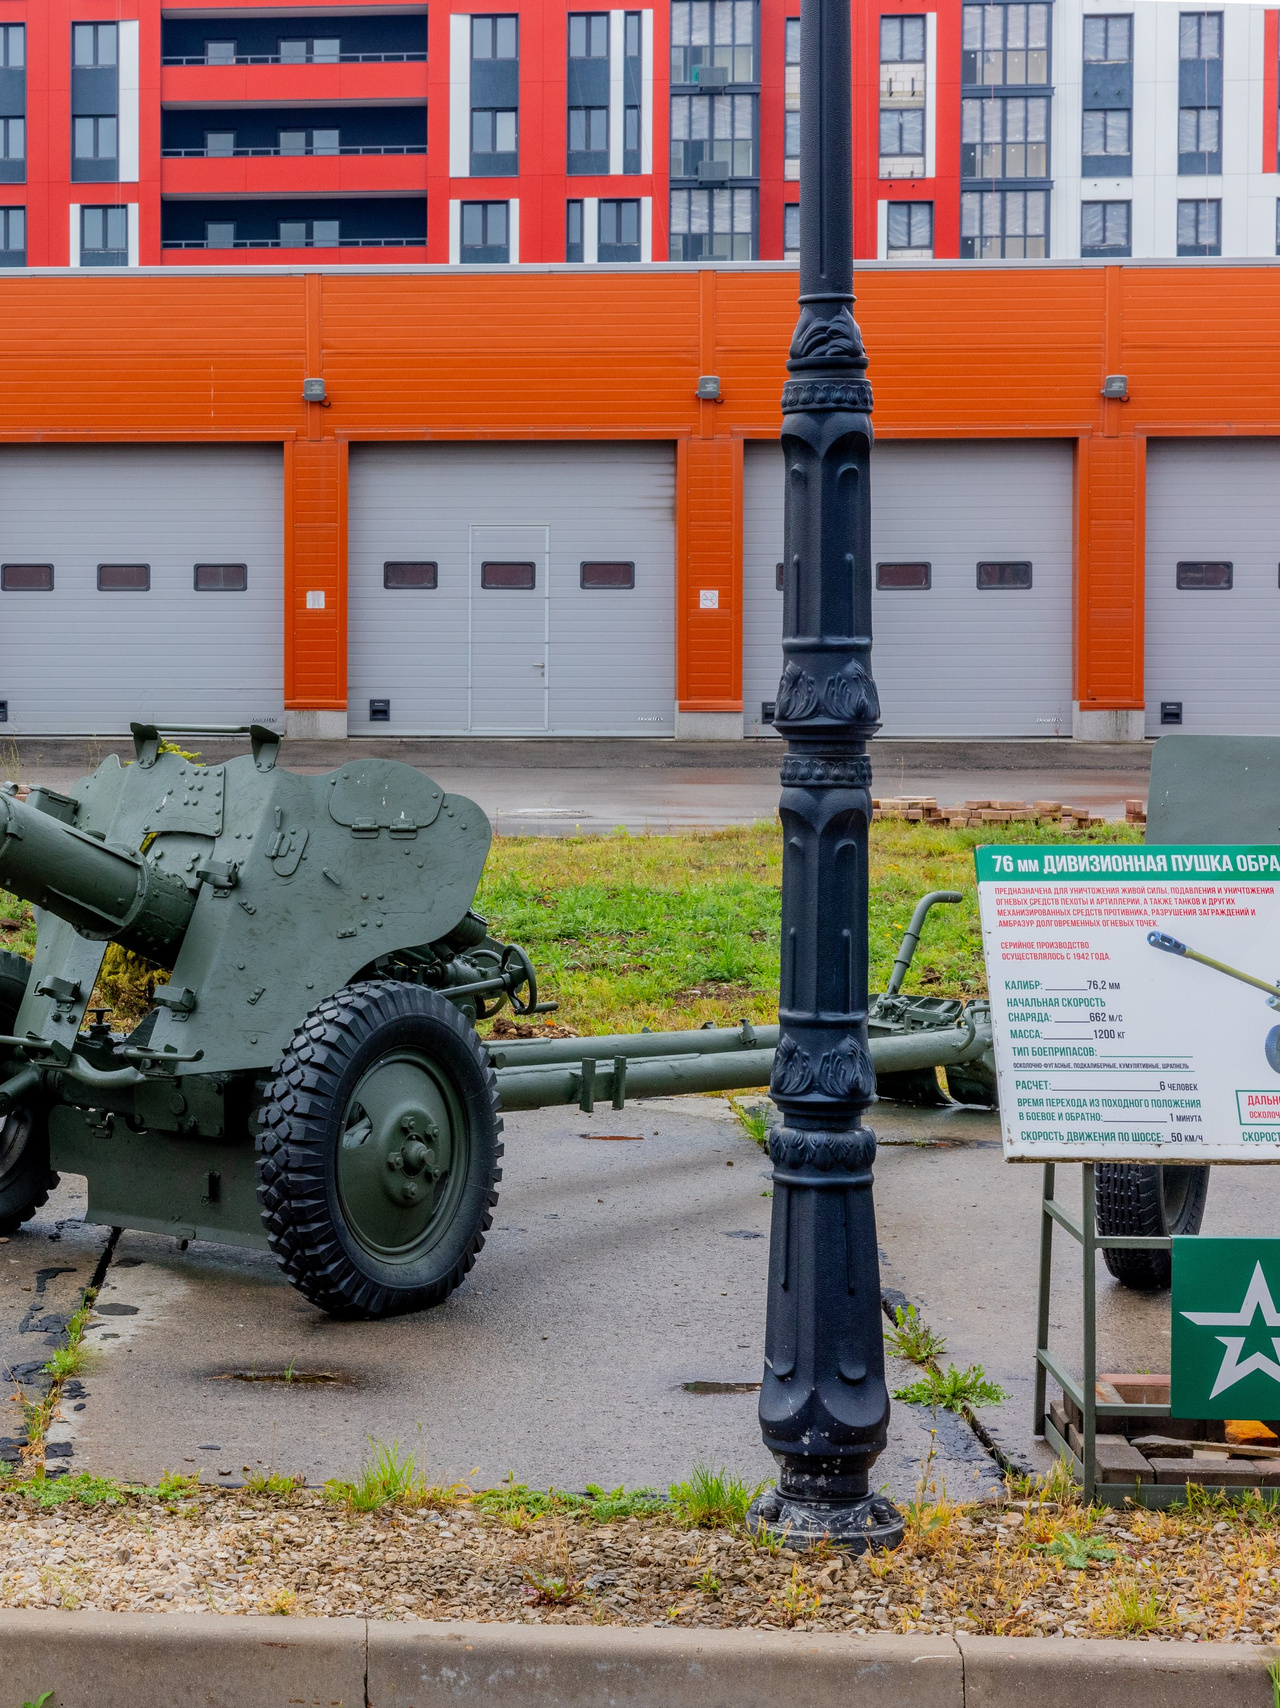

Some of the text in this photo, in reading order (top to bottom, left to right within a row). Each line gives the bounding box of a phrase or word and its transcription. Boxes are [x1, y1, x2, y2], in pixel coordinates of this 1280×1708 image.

[991, 855, 1014, 873] 76
[1043, 854, 1168, 875] ДИВИЗИОННАЯ
[1170, 854, 1234, 872] ПУШКА
[994, 887, 1053, 896] ПРЕДНАЗНАЧЕНА
[1053, 887, 1069, 895] ДЛЯ
[1069, 887, 1120, 895] УНИЧТОЖЕНИЯ
[1121, 886, 1146, 895] ЖИВОЙ
[1170, 887, 1217, 895] ПОДАВЛЕНИЯ
[1223, 887, 1275, 895] УНИЧТОЖЕНИЯ
[997, 908, 1072, 917] МЕХАНИЗИРОВАННЫХ
[1072, 908, 1103, 917] СРЕДСТВ
[1151, 908, 1198, 916] РАЗРУШЕНИЯ
[1198, 907, 1250, 917] ЗАГРАЖДЕНИЙ
[1250, 908, 1256, 916] И
[998, 919, 1035, 928] АМБРАЗУР
[1035, 919, 1101, 928] ДОЛГОВРЕМЕННЫХ
[1101, 919, 1135, 927] ОГНЕВЫХ
[1000, 941, 1090, 950] СЕРИЙНОЕ ПРОИЗВОДСТВО
[1001, 952, 1066, 961] ОСУЩЕСТВЛЯЛОСЬ
[1066, 952, 1071, 961] С
[1073, 952, 1090, 961] 1942
[1004, 980, 1044, 990] КАЛИБР:
[1087, 980, 1107, 991] 76,2
[1006, 997, 1106, 1008] НАЧАЛЬНАЯ СКОРОСТЬ
[1008, 1012, 1053, 1023] СНАРЯДА:
[1089, 1012, 1107, 1022] 662
[1010, 1029, 1044, 1039] МАССА:
[1093, 1029, 1116, 1039] 1200
[1011, 1046, 1099, 1057] ТИП БОЕПРИПАСОВ:
[1015, 1080, 1053, 1090] РАСЧЕТ:
[1159, 1080, 1166, 1091] 6
[1017, 1098, 1202, 1109] ВРЕМЯ ПЕРЕХОДА ИЗ ПОХОДНОГО ПОЛОЖЕНИЯ
[1247, 1095, 1280, 1106] ДАЛЬН
[1018, 1111, 1025, 1121] В
[1025, 1111, 1056, 1121] БОЕВОЕ
[1057, 1112, 1064, 1121] И
[1065, 1112, 1104, 1122] ОБРАТНО:
[1169, 1113, 1174, 1122] 1
[1249, 1111, 1280, 1119] ОСКОЛОЧ
[1020, 1131, 1065, 1141] СКОРОСТЬ
[1066, 1131, 1116, 1142] ДВИЖЕНИЯ
[1117, 1132, 1130, 1142] ПО
[1131, 1132, 1166, 1143] ШОССЕ:
[1170, 1132, 1183, 1143] 50
